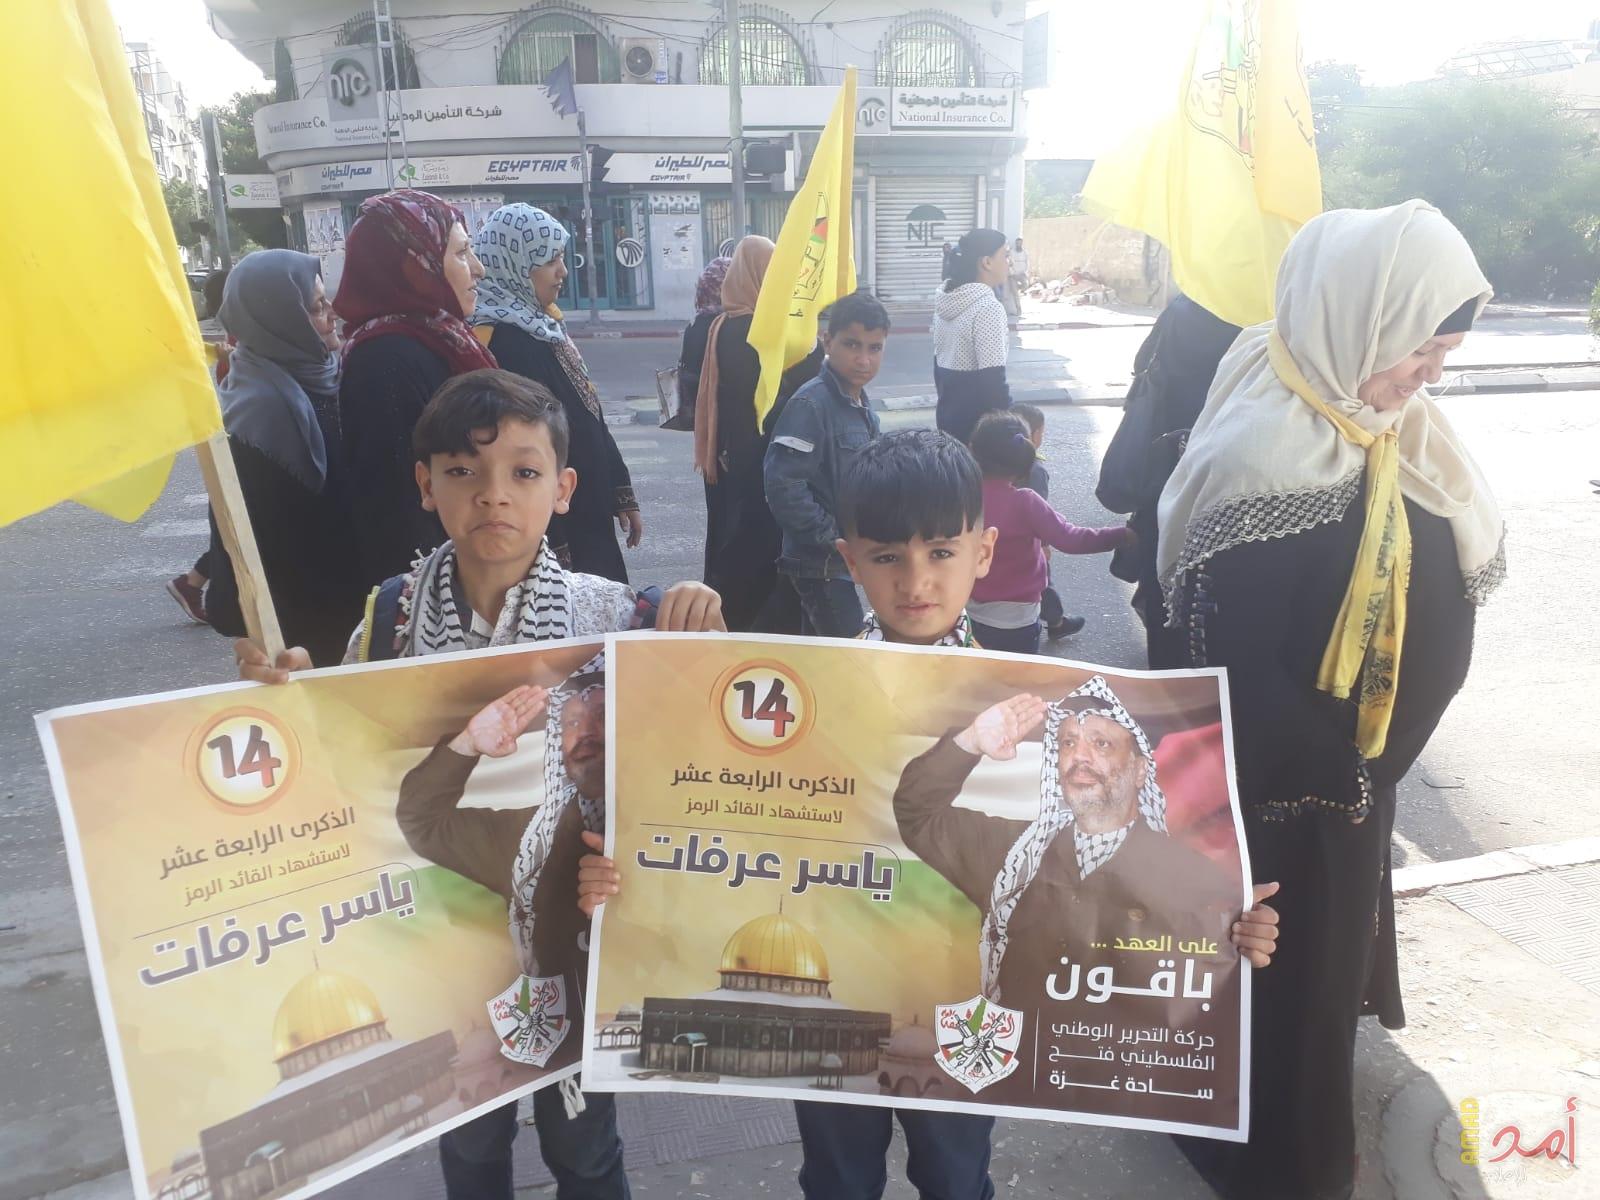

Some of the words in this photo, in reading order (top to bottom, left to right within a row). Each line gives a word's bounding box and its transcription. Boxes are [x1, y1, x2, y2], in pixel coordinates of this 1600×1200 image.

[312, 115, 328, 128] Co.
[423, 104, 463, 122] التأمين
[465, 104, 502, 119] شركة
[899, 111, 940, 122] National
[942, 111, 987, 122] Insurance
[989, 111, 1006, 123] Co.
[321, 164, 351, 181] للطيران
[350, 166, 372, 179] مصر
[487, 159, 569, 173] EGYPTAIR
[654, 155, 704, 172] للطيران
[649, 174, 686, 182] EGYPTAIR
[907, 222, 945, 248] NIC
[733, 678, 795, 738] 14
[206, 724, 282, 788] 14
[670, 762, 713, 787] عشر
[718, 767, 782, 793] الرابعة
[788, 777, 856, 798] الذكرى
[685, 796, 719, 815] الرمز
[723, 798, 764, 817] القائد
[768, 804, 843, 824] لاستشهاد
[290, 806, 356, 840] الذكرى
[214, 823, 284, 859] الرابعة
[159, 845, 209, 880] عشر
[278, 843, 351, 878] لاستشهاد
[636, 832, 782, 889] عرفات
[229, 864, 273, 890] القائد
[791, 850, 895, 903] ياسر
[183, 877, 223, 907] الرمز
[319, 870, 416, 945] ياسر
[137, 910, 307, 988] عرفات
[1113, 935, 1172, 952] العهد
[1178, 937, 1218, 955] على
[1051, 1020, 1113, 1041] الوطني
[1117, 1027, 1169, 1045] التحرير
[1174, 1029, 1215, 1051] حركة
[1120, 1047, 1215, 1072] الفلسطيني
